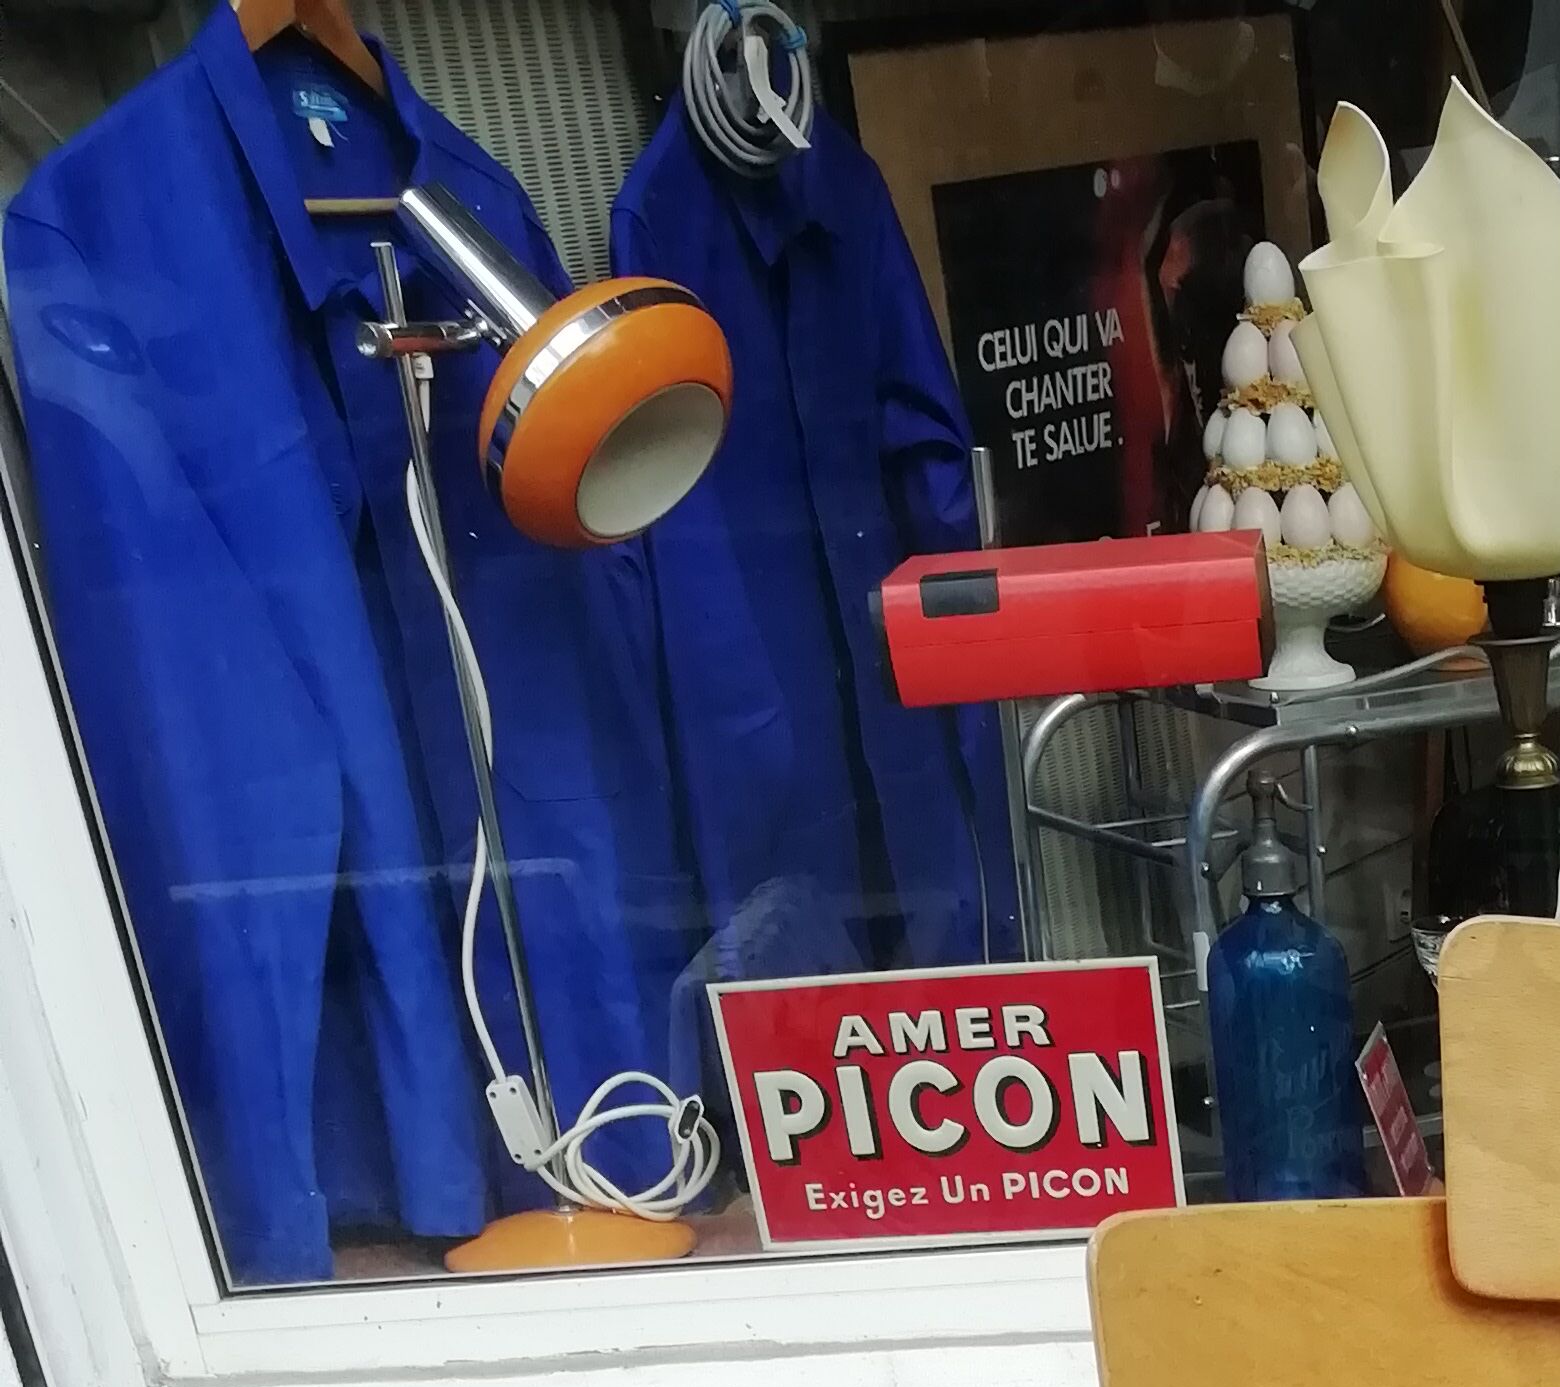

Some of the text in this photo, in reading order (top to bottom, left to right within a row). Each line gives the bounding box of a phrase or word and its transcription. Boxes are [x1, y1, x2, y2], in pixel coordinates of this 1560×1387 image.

[977, 307, 1125, 372] CELUI QUI VA
[1005, 361, 1114, 419] CHANTER
[1012, 428, 1039, 469] TE
[833, 1004, 1053, 1058] AMER
[753, 1050, 1155, 1165] PICON
[804, 1167, 1130, 1220] Exigez Un PICON
